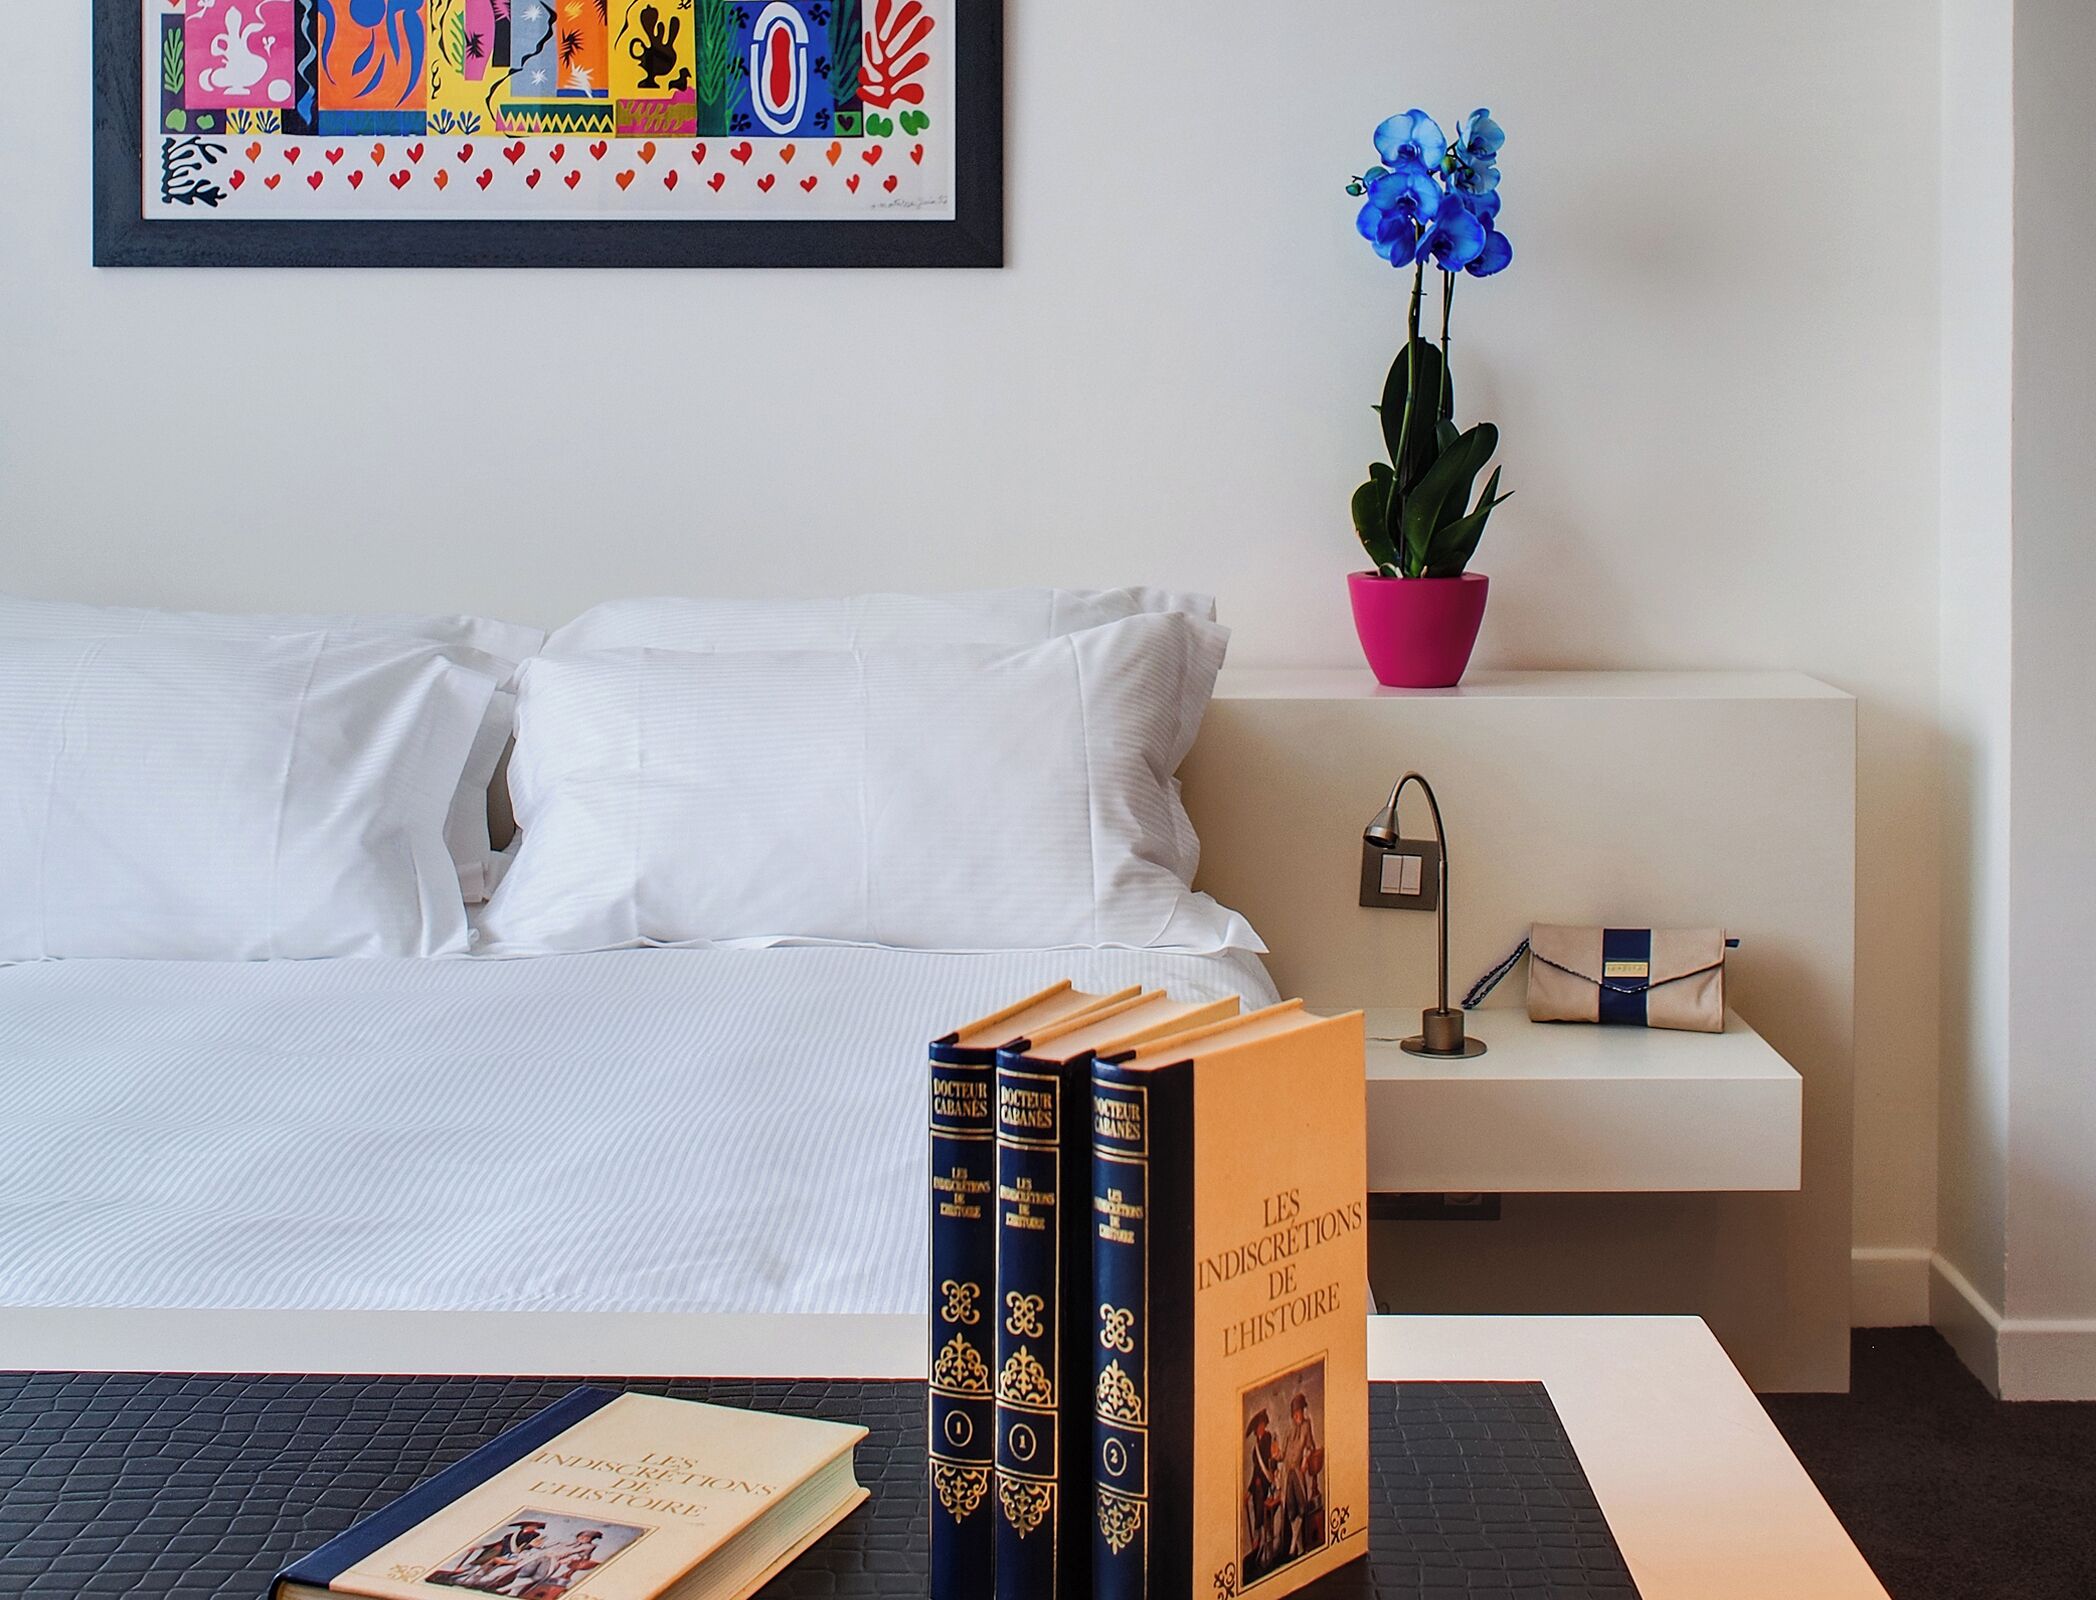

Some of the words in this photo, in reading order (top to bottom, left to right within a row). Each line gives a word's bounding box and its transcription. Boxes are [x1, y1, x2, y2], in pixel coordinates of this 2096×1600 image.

[934, 1078, 987, 1098] DOCTEUR
[1000, 1086, 1052, 1109] DOCTEUR
[1263, 1188, 1300, 1228] LES
[1197, 1201, 1362, 1292] INDISCRÉTIONS
[1268, 1263, 1298, 1302] DE
[1222, 1281, 1341, 1358] L'HISTOIRE
[640, 1452, 699, 1470] LES
[527, 1480, 708, 1518] L'HISTOIRE
[610, 1477, 660, 1494] DE
